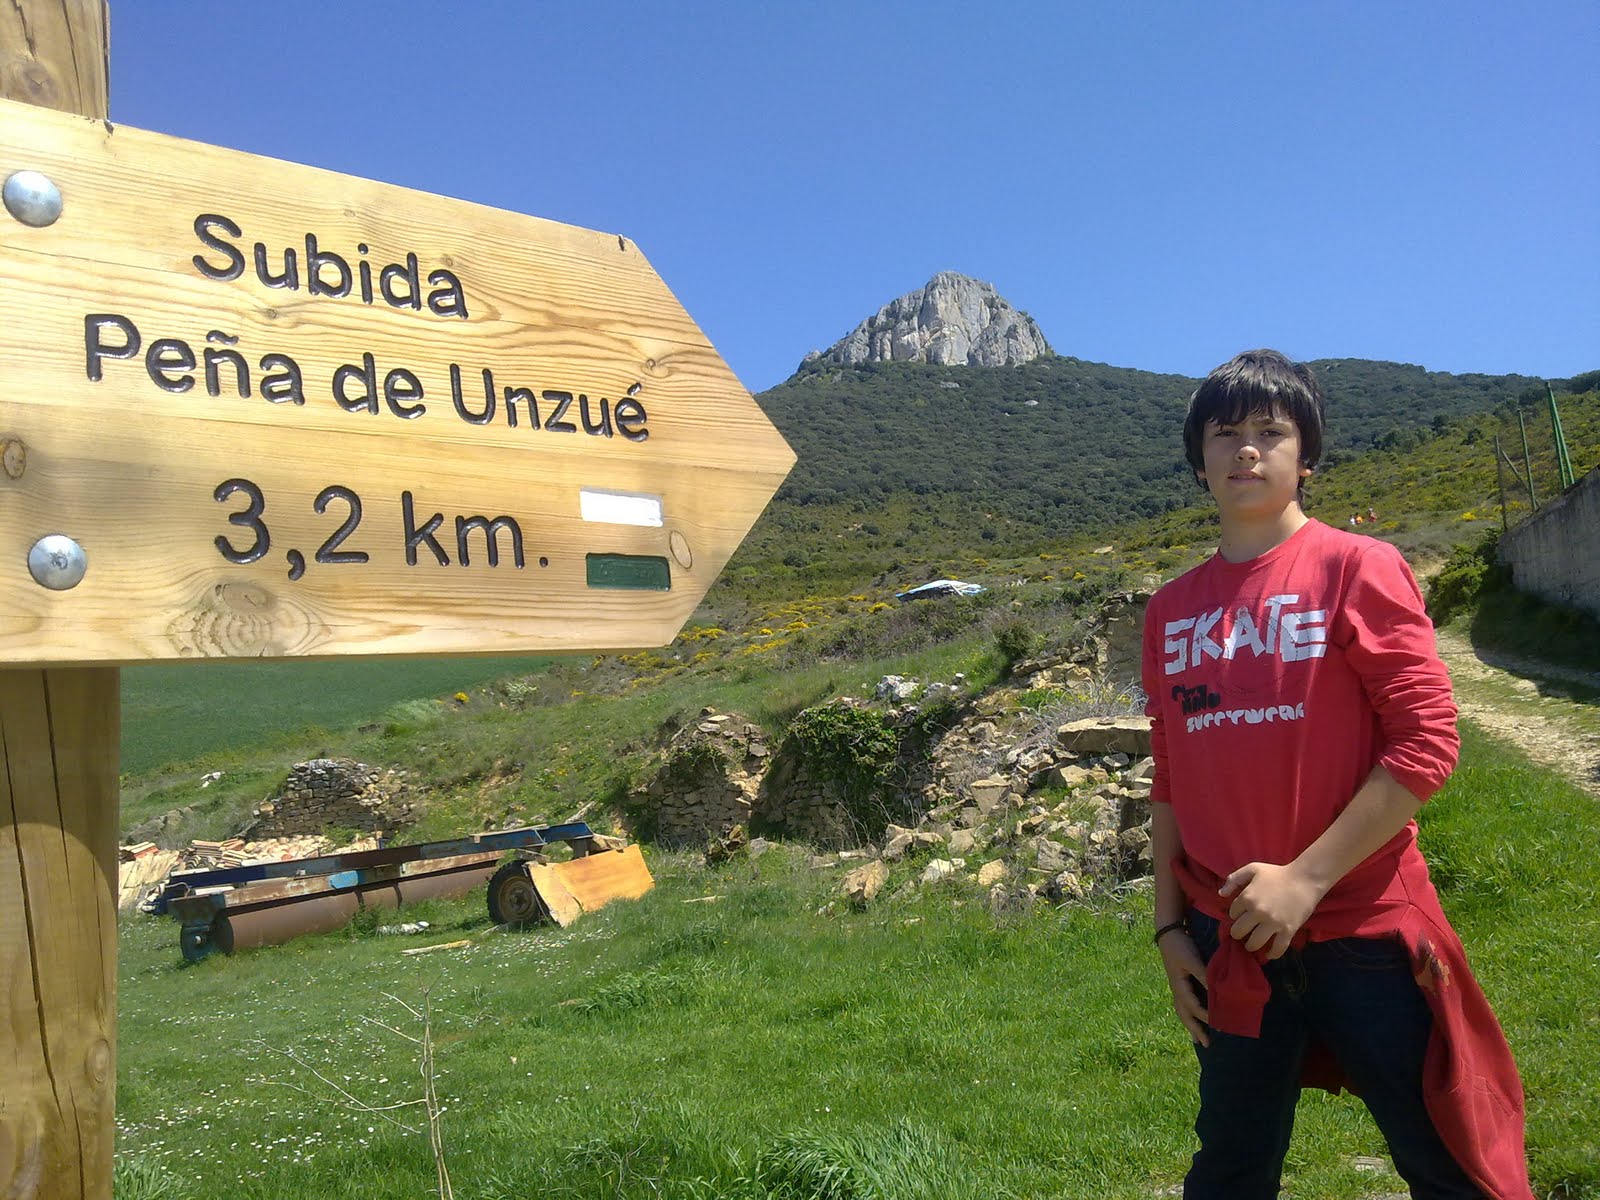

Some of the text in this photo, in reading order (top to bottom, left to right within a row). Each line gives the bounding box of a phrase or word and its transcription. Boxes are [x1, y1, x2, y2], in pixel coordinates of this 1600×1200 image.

[193, 213, 469, 320] Subida
[84, 313, 650, 442] Peña de Unzué
[213, 478, 549, 580] 3,2 km.
[1164, 594, 1328, 675] SKATE
